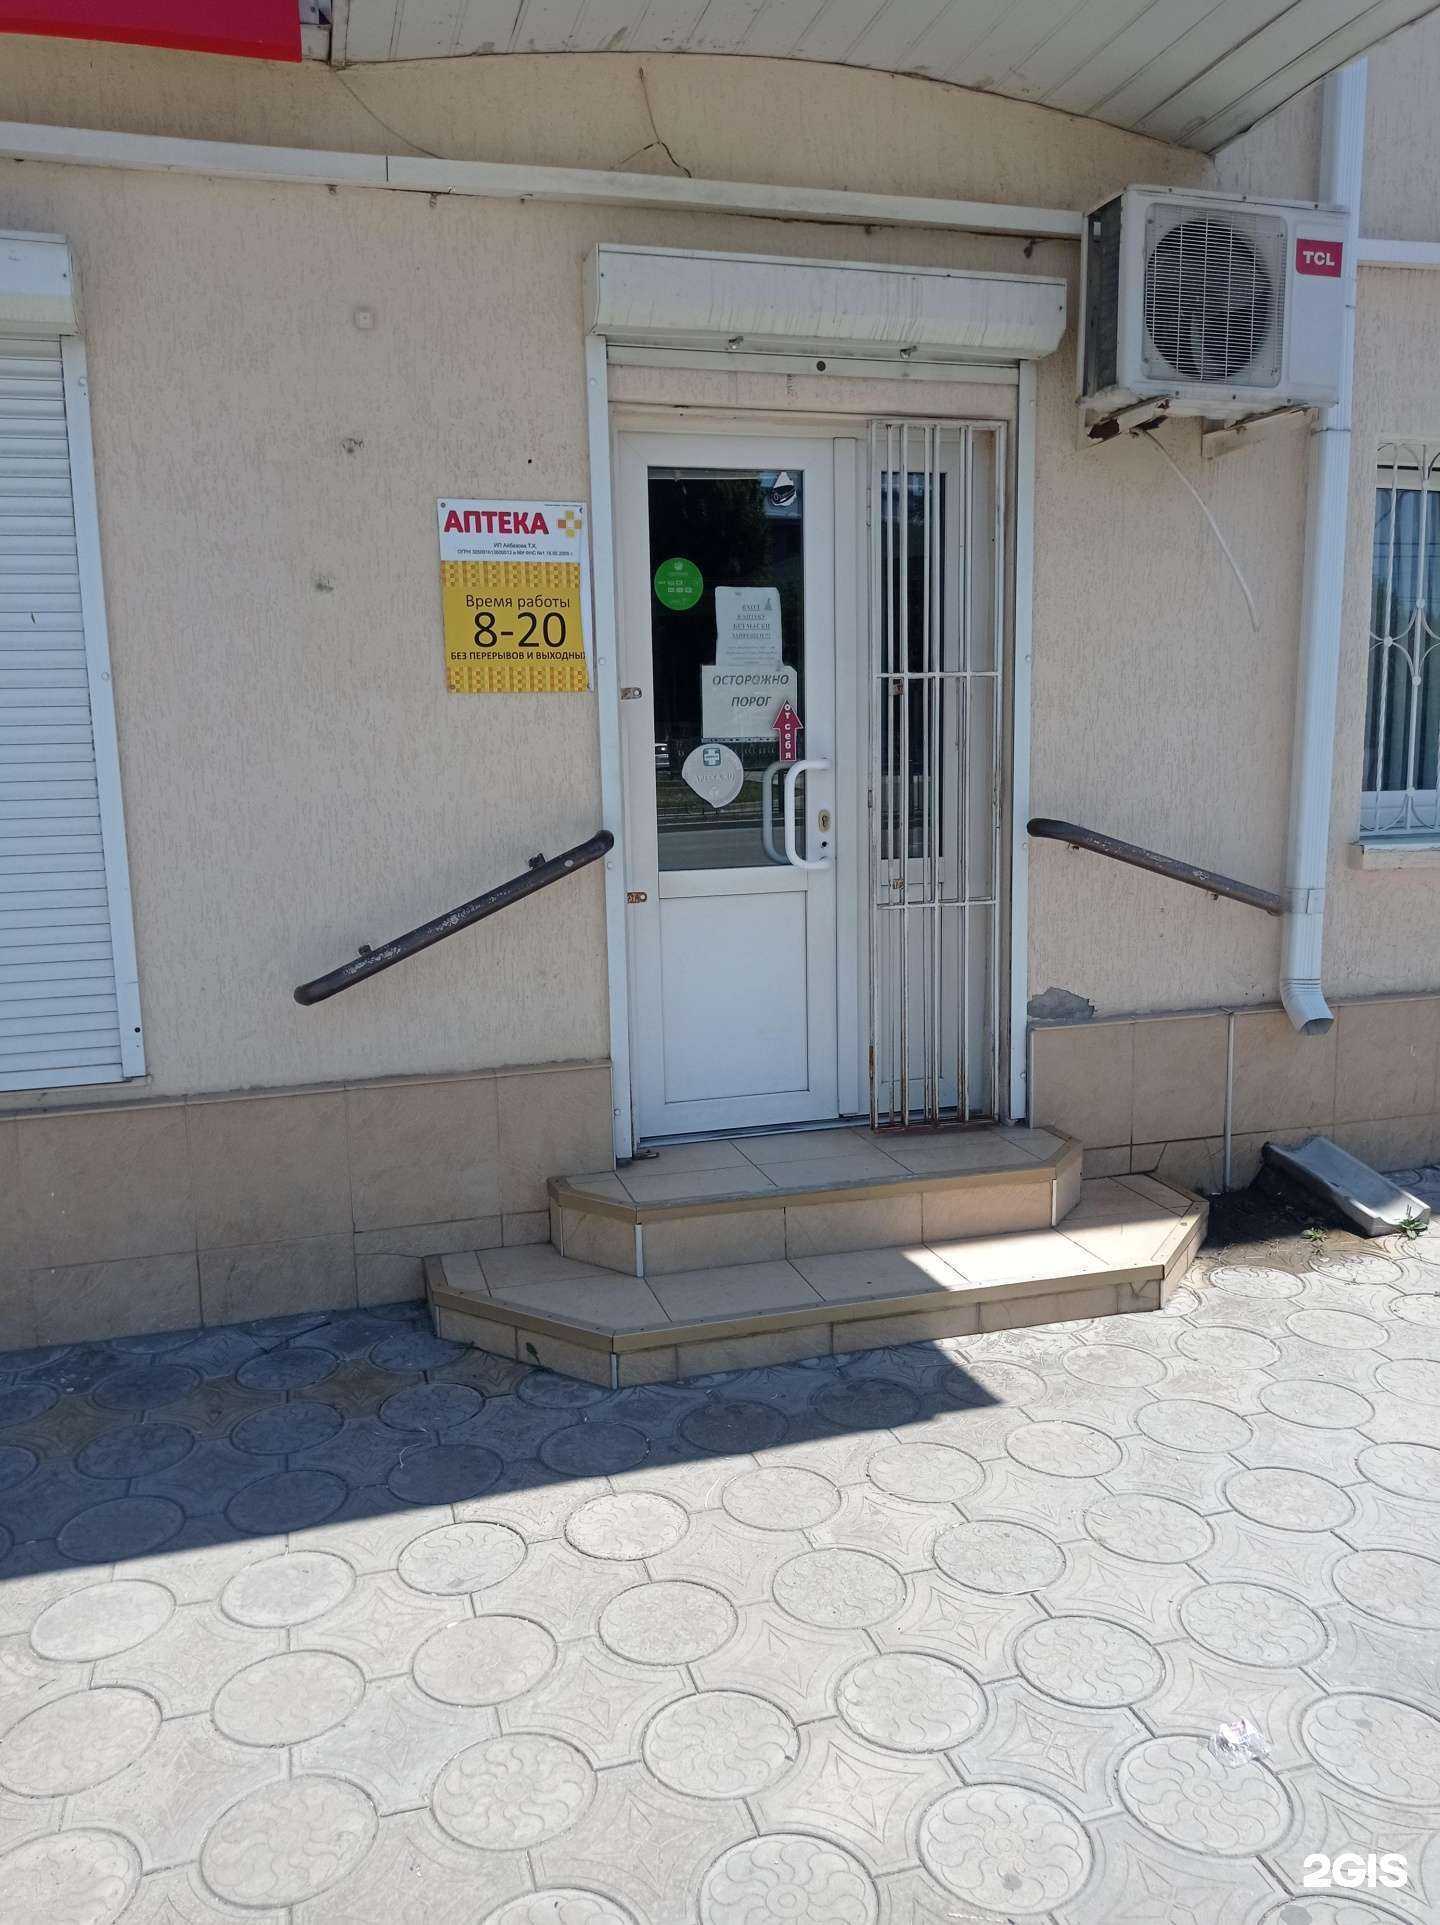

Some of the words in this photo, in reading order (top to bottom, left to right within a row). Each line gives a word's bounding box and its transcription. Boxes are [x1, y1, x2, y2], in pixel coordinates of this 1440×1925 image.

[1302, 250, 1336, 266] TCL
[444, 510, 549, 534] АПТЕКА
[466, 594, 512, 609] Время
[518, 594, 570, 609] работы
[474, 611, 567, 648] 8-20
[451, 652, 467, 660] БЕЗ
[469, 651, 524, 660] ПЕРЕРЫВОВ
[526, 652, 533, 660] И
[712, 675, 789, 686] ОСТОРОЖНО
[731, 696, 772, 707] ПОРОГ
